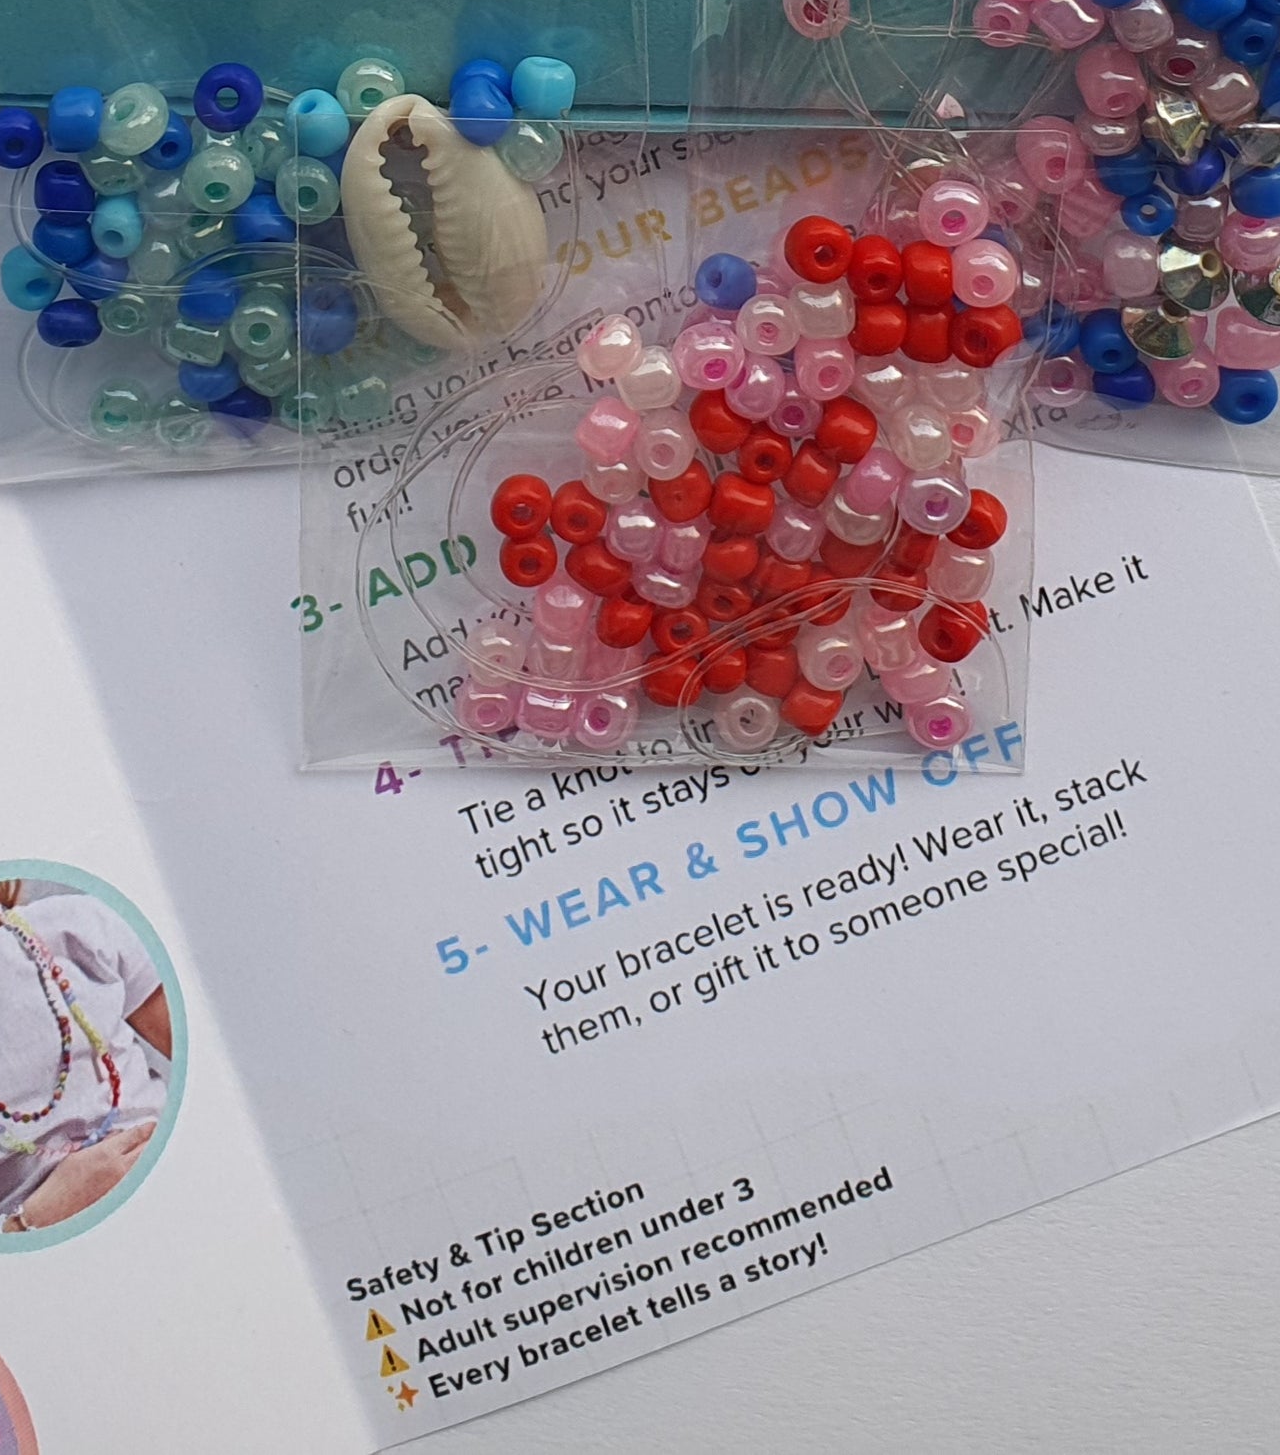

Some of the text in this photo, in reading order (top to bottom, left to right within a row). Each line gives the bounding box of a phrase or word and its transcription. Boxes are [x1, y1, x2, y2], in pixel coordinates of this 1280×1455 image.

[556, 134, 870, 275] OUR BEADS
[586, 145, 661, 201] your
[290, 534, 477, 633] 3- ADD
[1019, 571, 1116, 623] Make
[1121, 554, 1149, 585] it
[374, 760, 422, 795] 4-
[458, 799, 516, 835] Tie
[524, 787, 547, 811] a
[475, 827, 557, 879] tight
[562, 814, 603, 846] so
[609, 796, 636, 827] it
[642, 765, 730, 815] stays
[435, 721, 1023, 975] 5- WEAR & SHOW OFF
[524, 758, 1149, 1012] Your bracelet is ready! Wear it, stack
[541, 808, 1128, 1055] them, or gift it to someone special!
[346, 1182, 645, 1302] Safety & Tip Section
[400, 1177, 755, 1325] Not for children under 3
[418, 1166, 894, 1363] Adult supervision recommended
[428, 1232, 829, 1399] Every bracelet tells a story!
